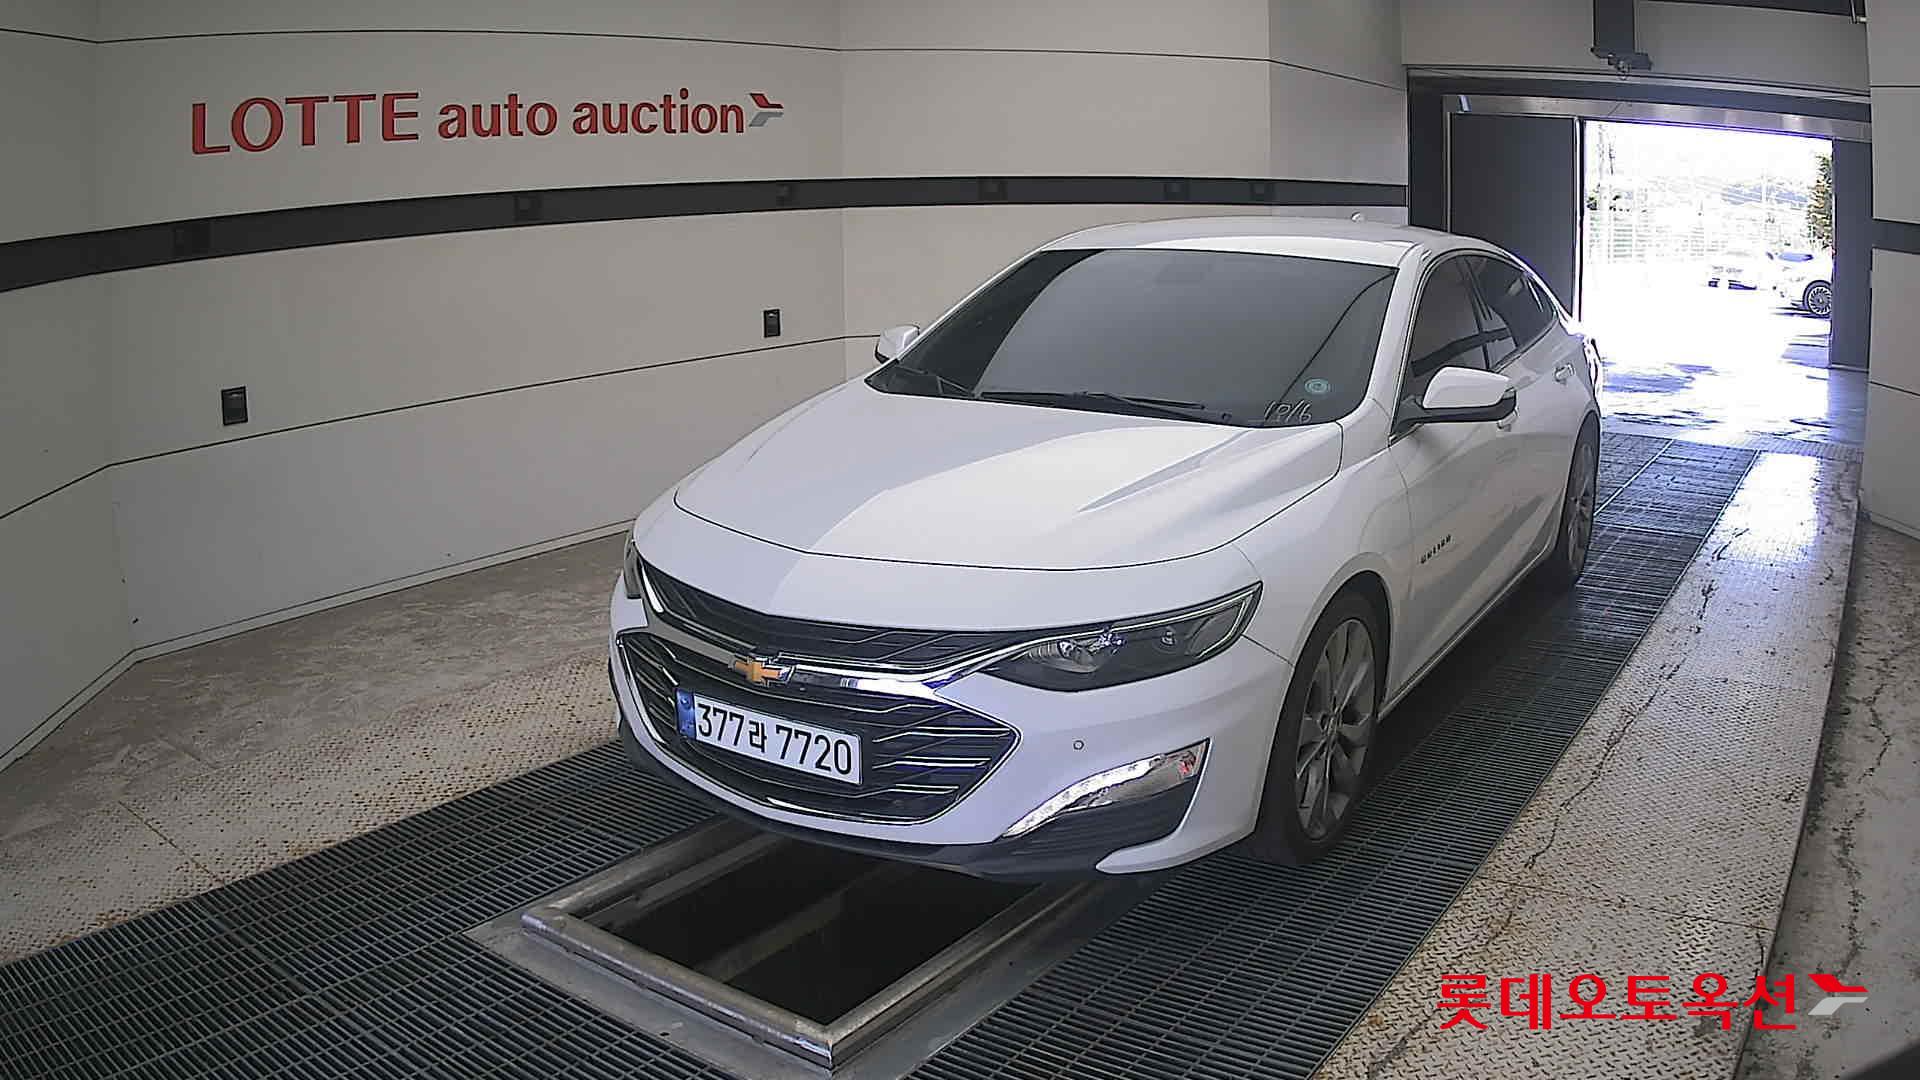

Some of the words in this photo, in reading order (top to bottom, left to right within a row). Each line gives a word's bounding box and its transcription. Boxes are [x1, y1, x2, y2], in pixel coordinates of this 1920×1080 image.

[191, 93, 419, 154] LOTTE
[438, 93, 558, 139] auto
[572, 88, 744, 134] auction
[697, 703, 768, 754] 377라
[776, 724, 852, 775] 7720
